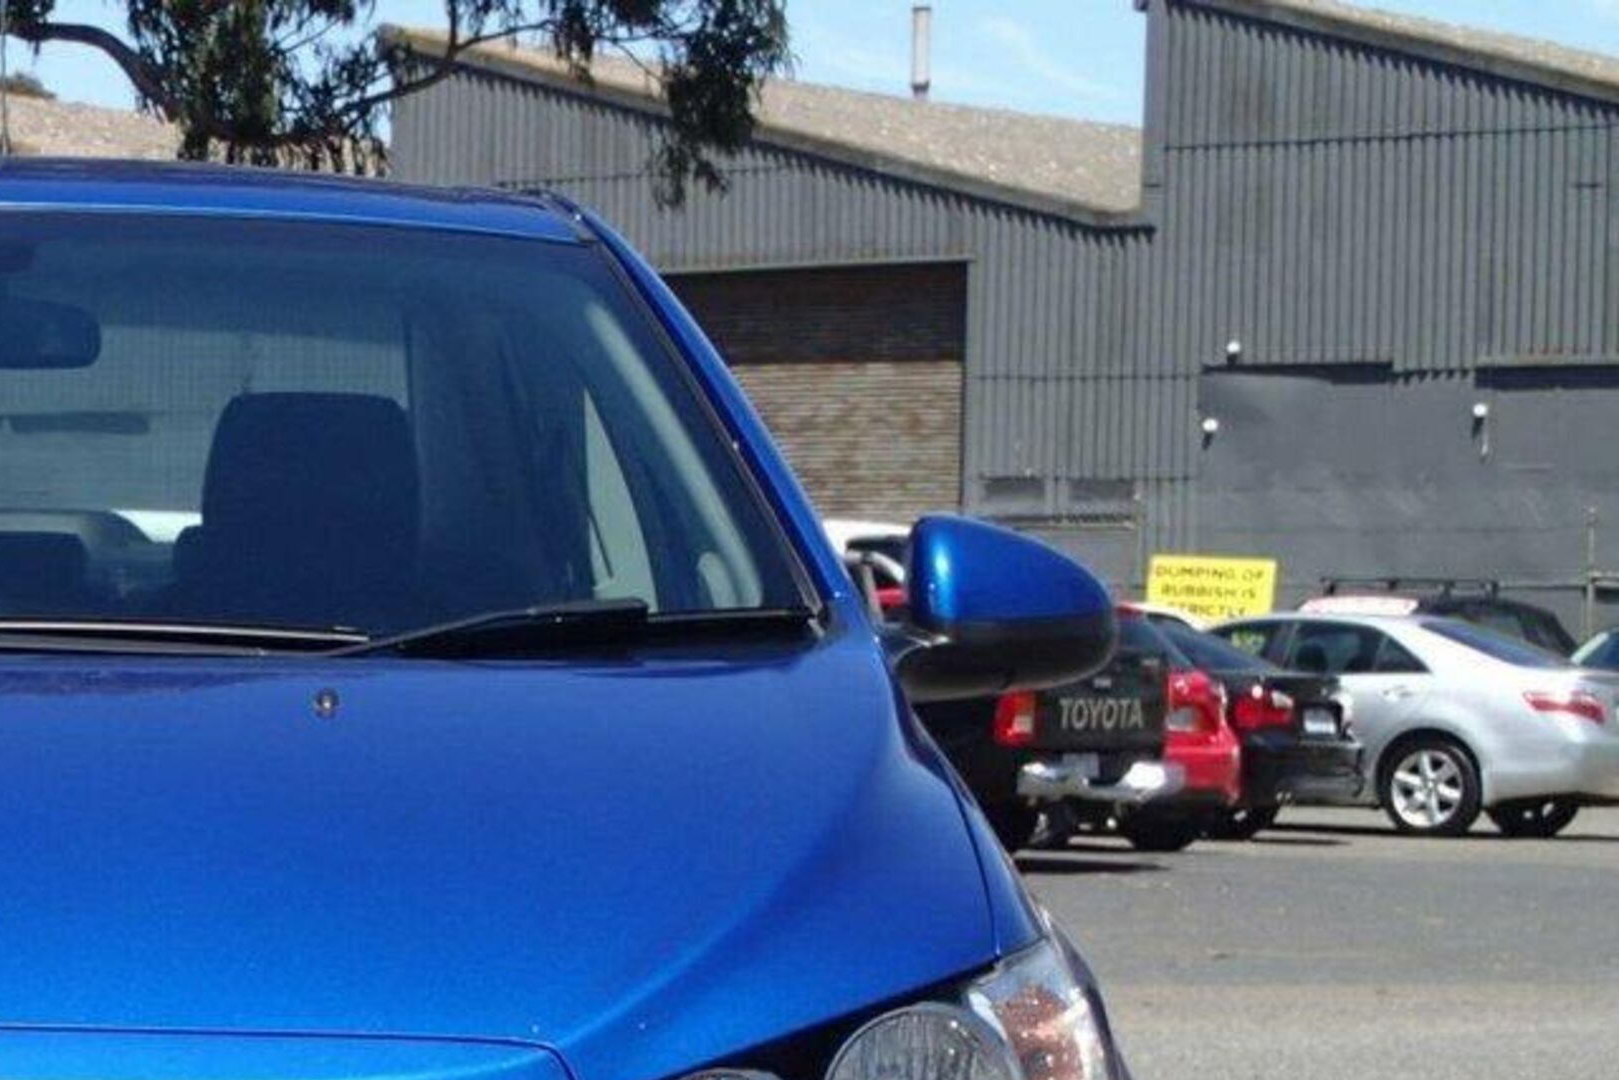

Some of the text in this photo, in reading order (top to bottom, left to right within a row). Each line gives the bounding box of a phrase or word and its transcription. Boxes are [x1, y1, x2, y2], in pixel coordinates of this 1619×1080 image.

[1155, 565, 1264, 582] DUMPING OF
[1161, 584, 1256, 600] RUBBISH IS
[1058, 698, 1145, 730] TOYOTA
